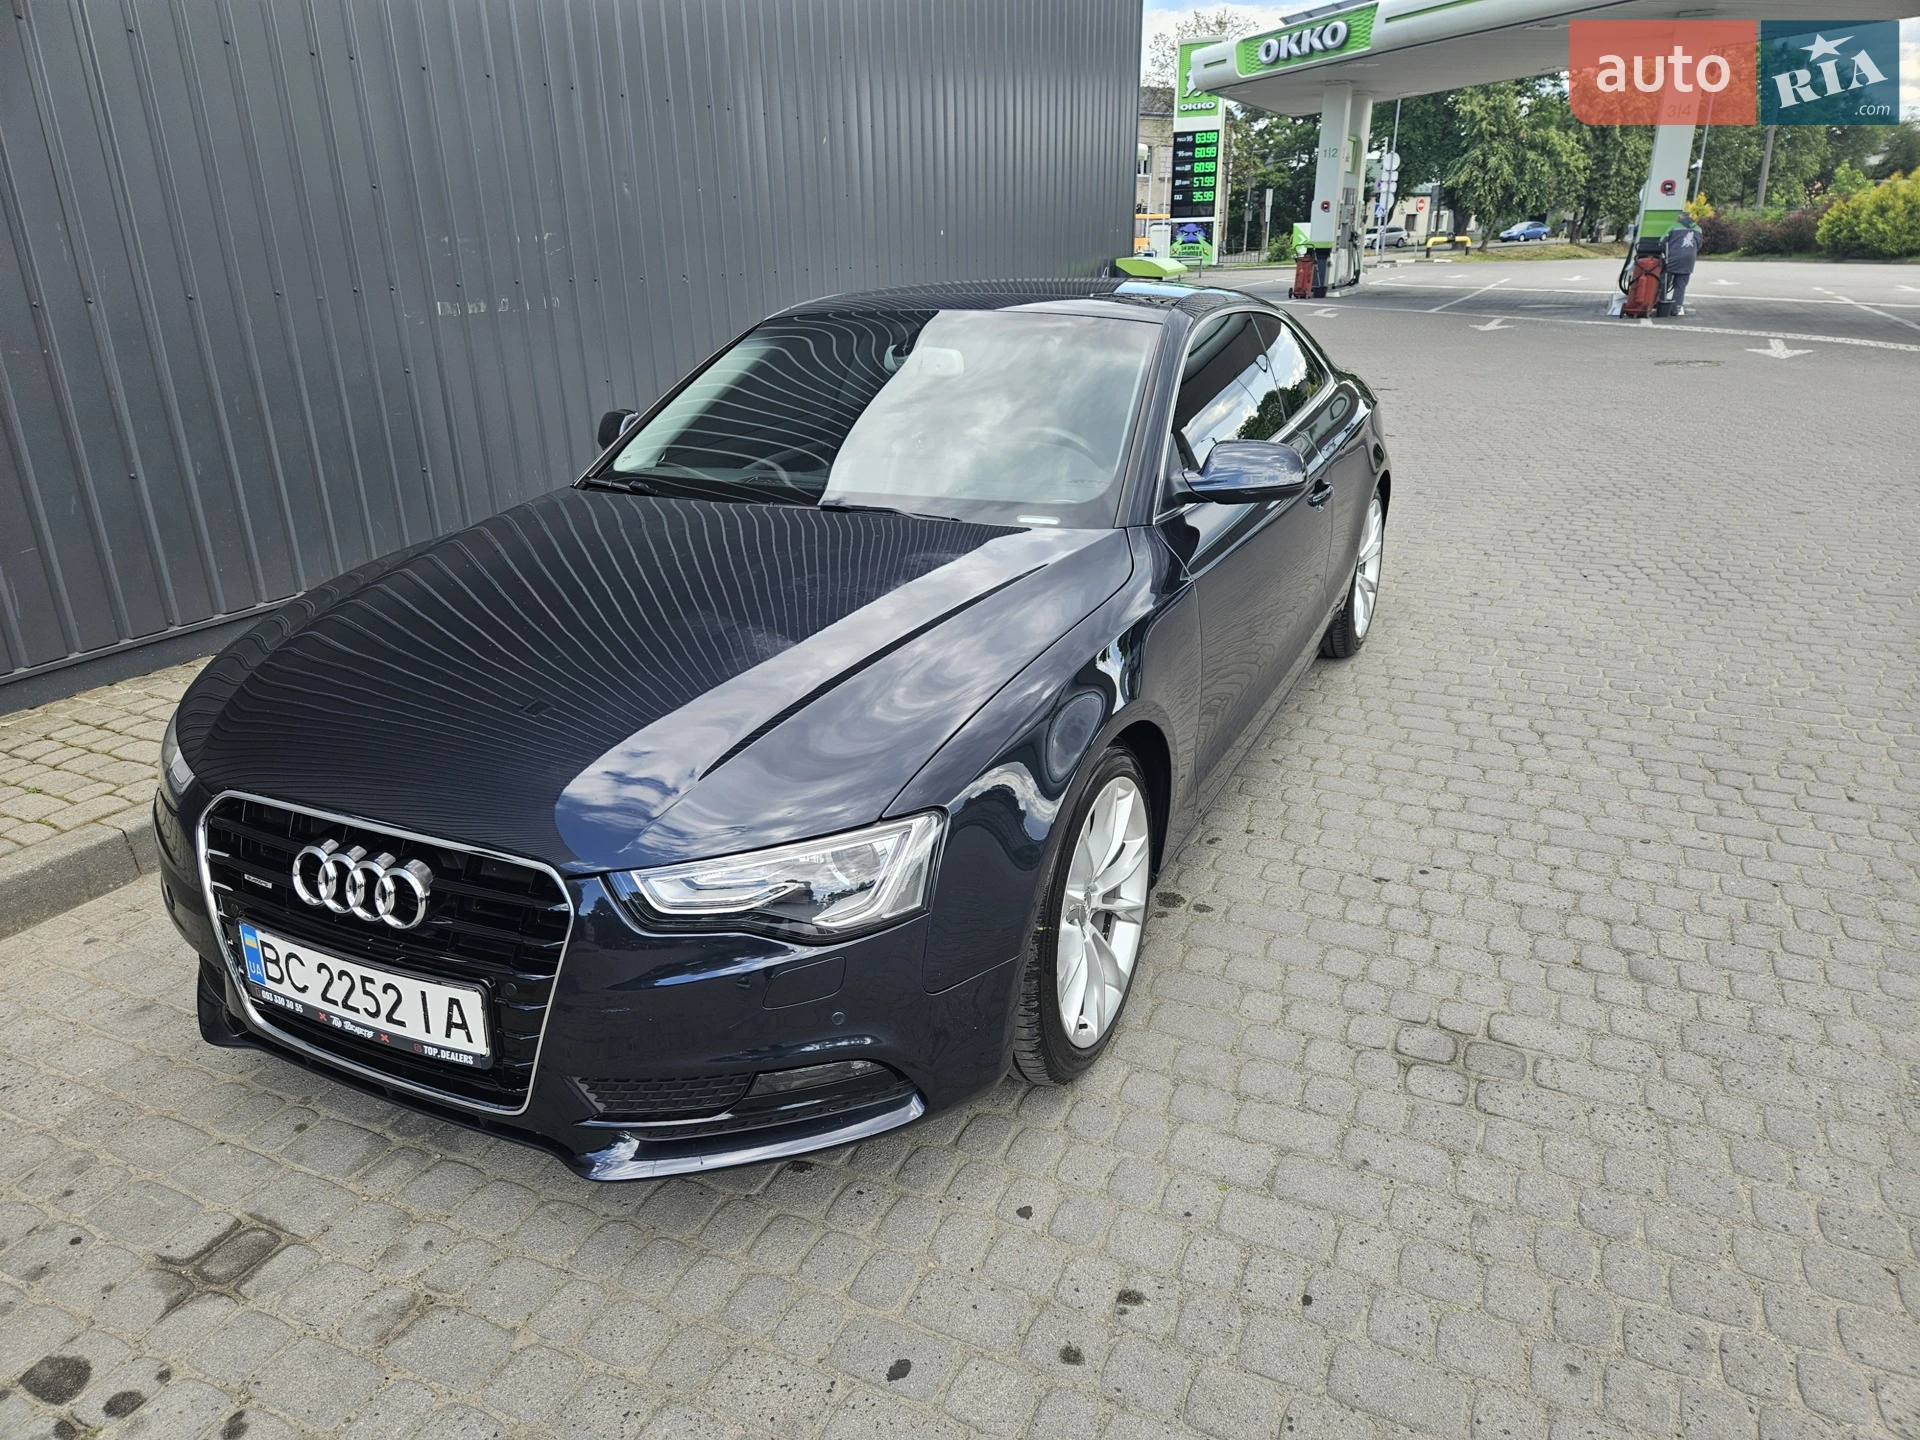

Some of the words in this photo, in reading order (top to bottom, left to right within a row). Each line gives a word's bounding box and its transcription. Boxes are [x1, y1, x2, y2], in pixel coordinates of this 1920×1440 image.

[1257, 19, 1349, 65] OKKO
[1179, 101, 1216, 112] OKKO
[1195, 132, 1218, 144] 63.99
[1194, 147, 1217, 158] 60.99
[1194, 162, 1216, 173] 60.99
[1193, 176, 1215, 187] 57.99
[1192, 191, 1214, 202] 35.99
[250, 961, 263, 977] UA
[259, 939, 309, 994] BC
[317, 962, 407, 1028] 2252
[420, 990, 474, 1044] IA
[423, 1045, 474, 1065] TOP.DEALERS
